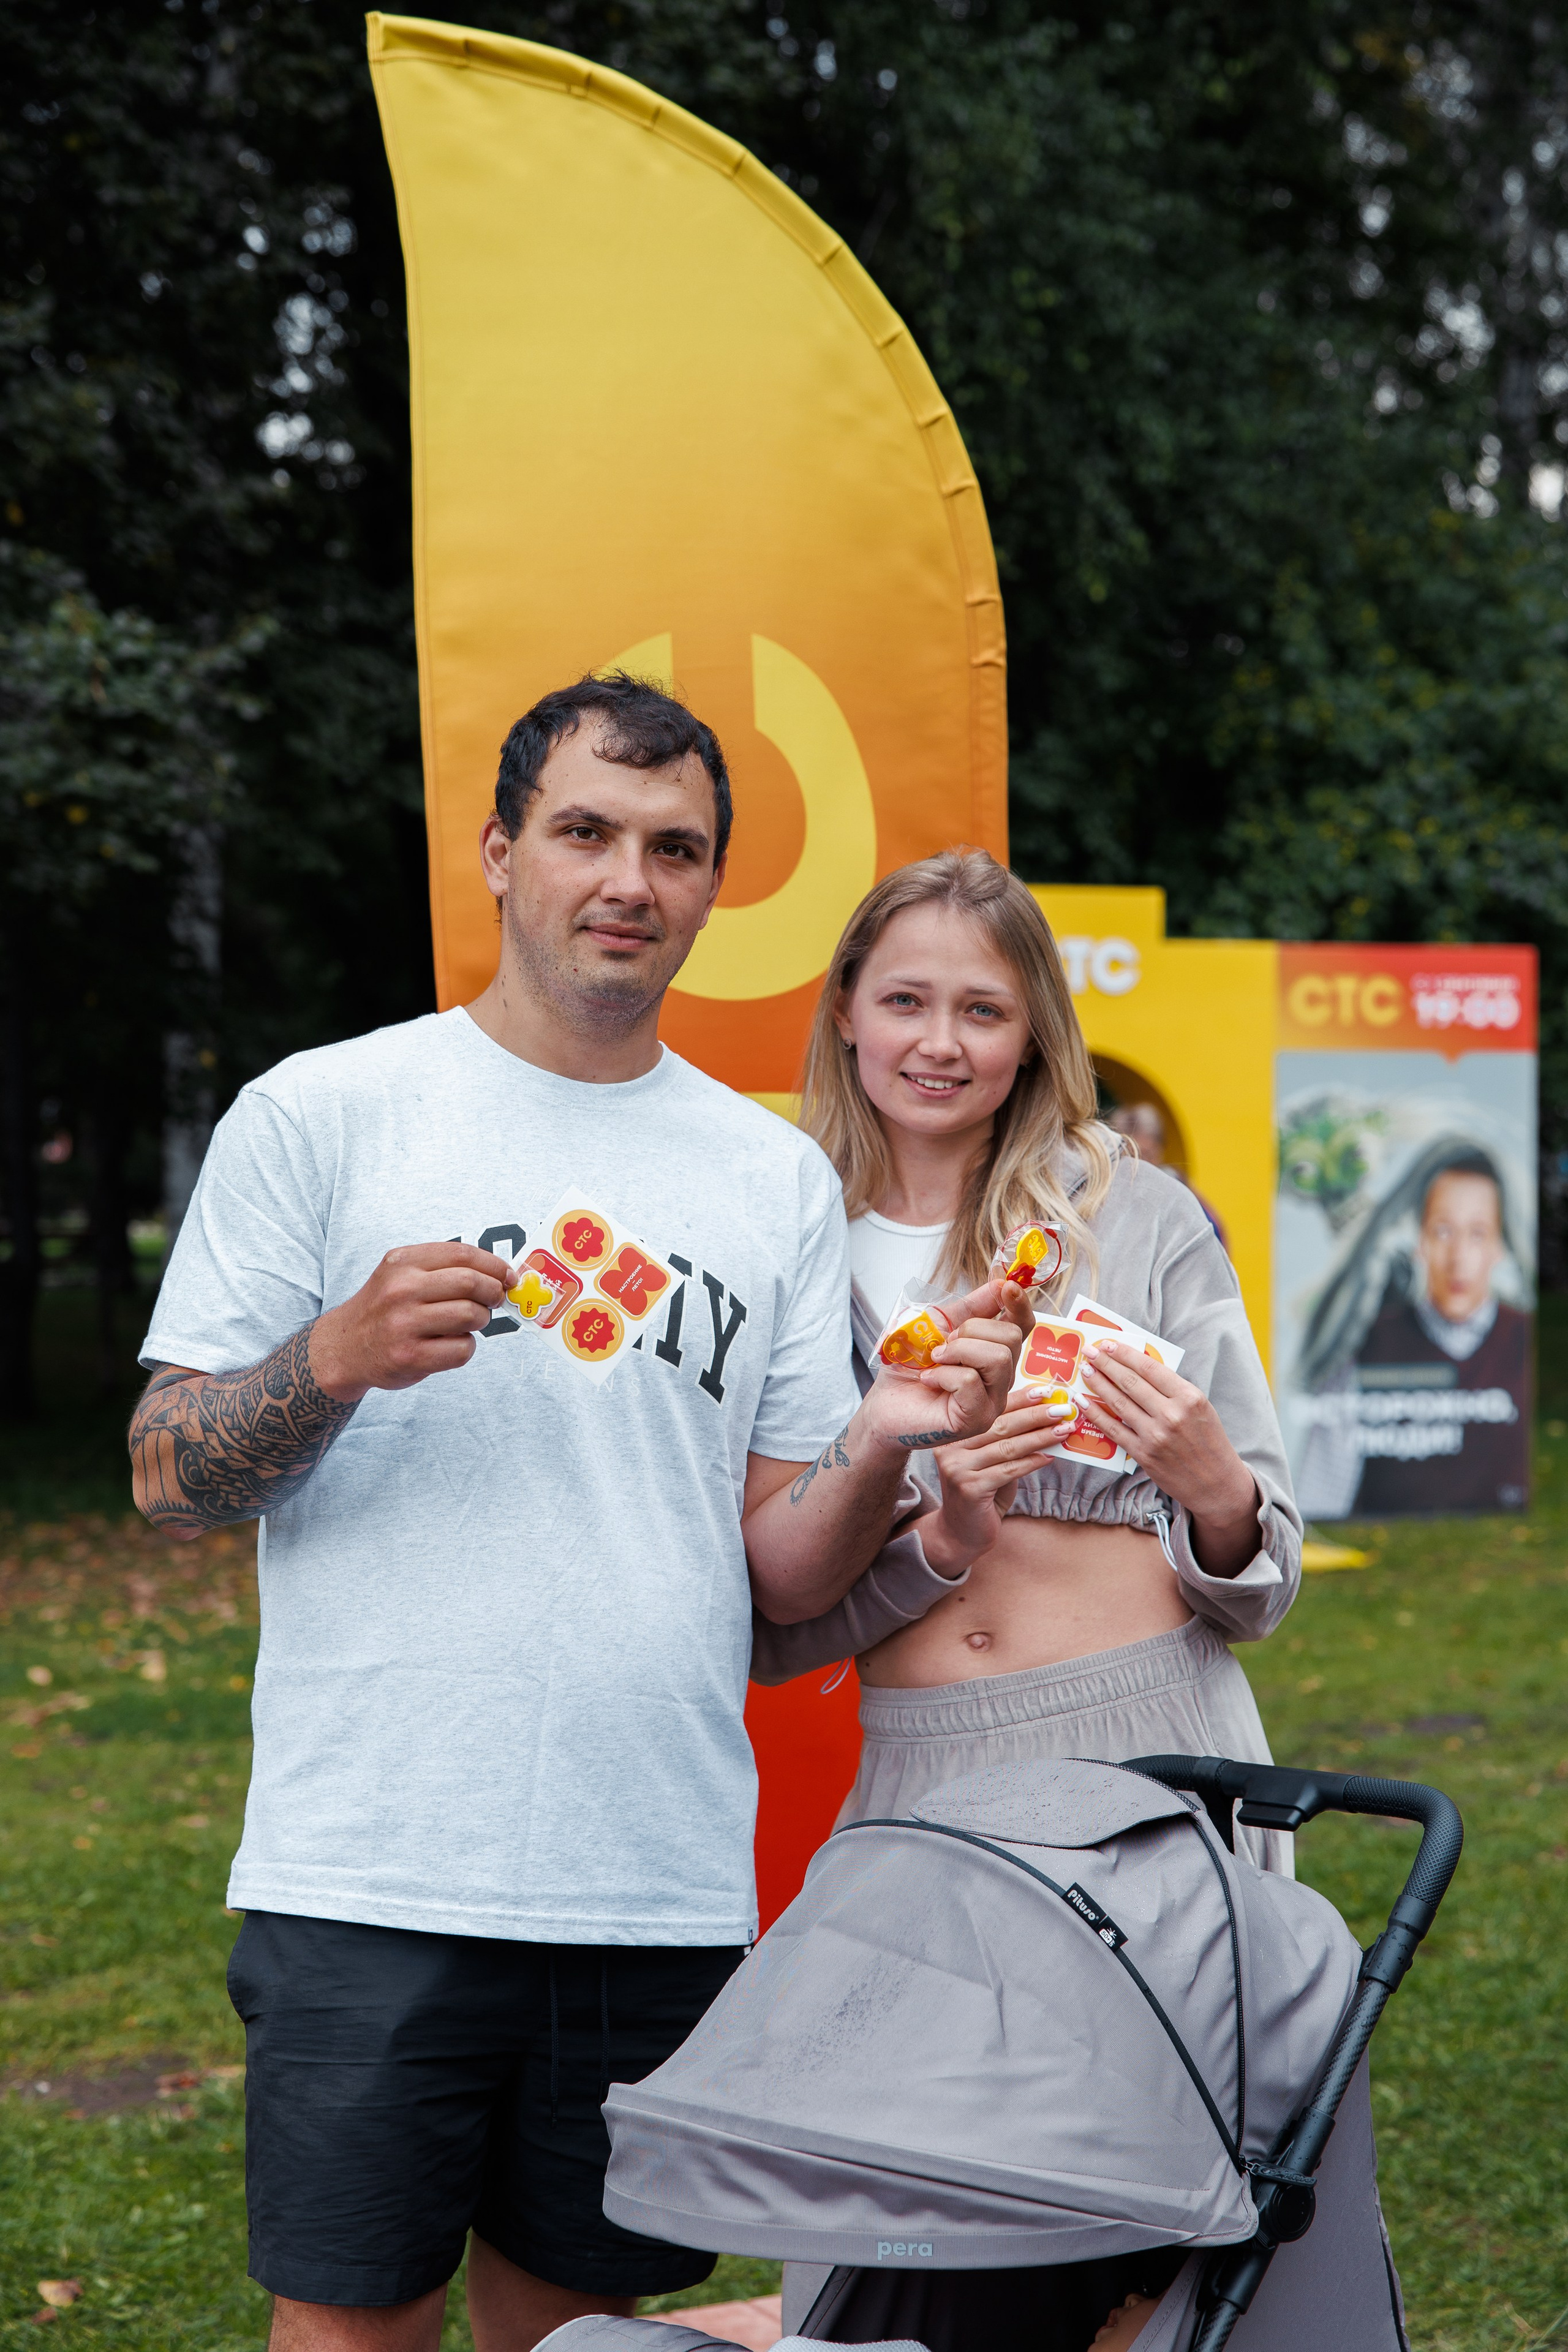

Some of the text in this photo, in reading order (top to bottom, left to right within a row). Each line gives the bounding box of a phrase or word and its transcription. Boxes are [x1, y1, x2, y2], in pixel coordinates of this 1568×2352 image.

[1059, 938, 1140, 995] ТС
[1289, 974, 1401, 1027] СТС
[575, 1229, 592, 1250] СТС
[618, 1264, 643, 1293] НАСТРОЕНИЕ
[631, 1278, 644, 1292] ЛЕТО!
[583, 1319, 604, 1342] СТС
[1036, 1352, 1068, 1363] НАСТРОЕНИЕ
[513, 1359, 641, 1397] JENS
[1081, 1428, 1104, 1439] ВРЕМЯ
[1101, 1931, 1110, 1941] 50+
[877, 2241, 933, 2261] pera
